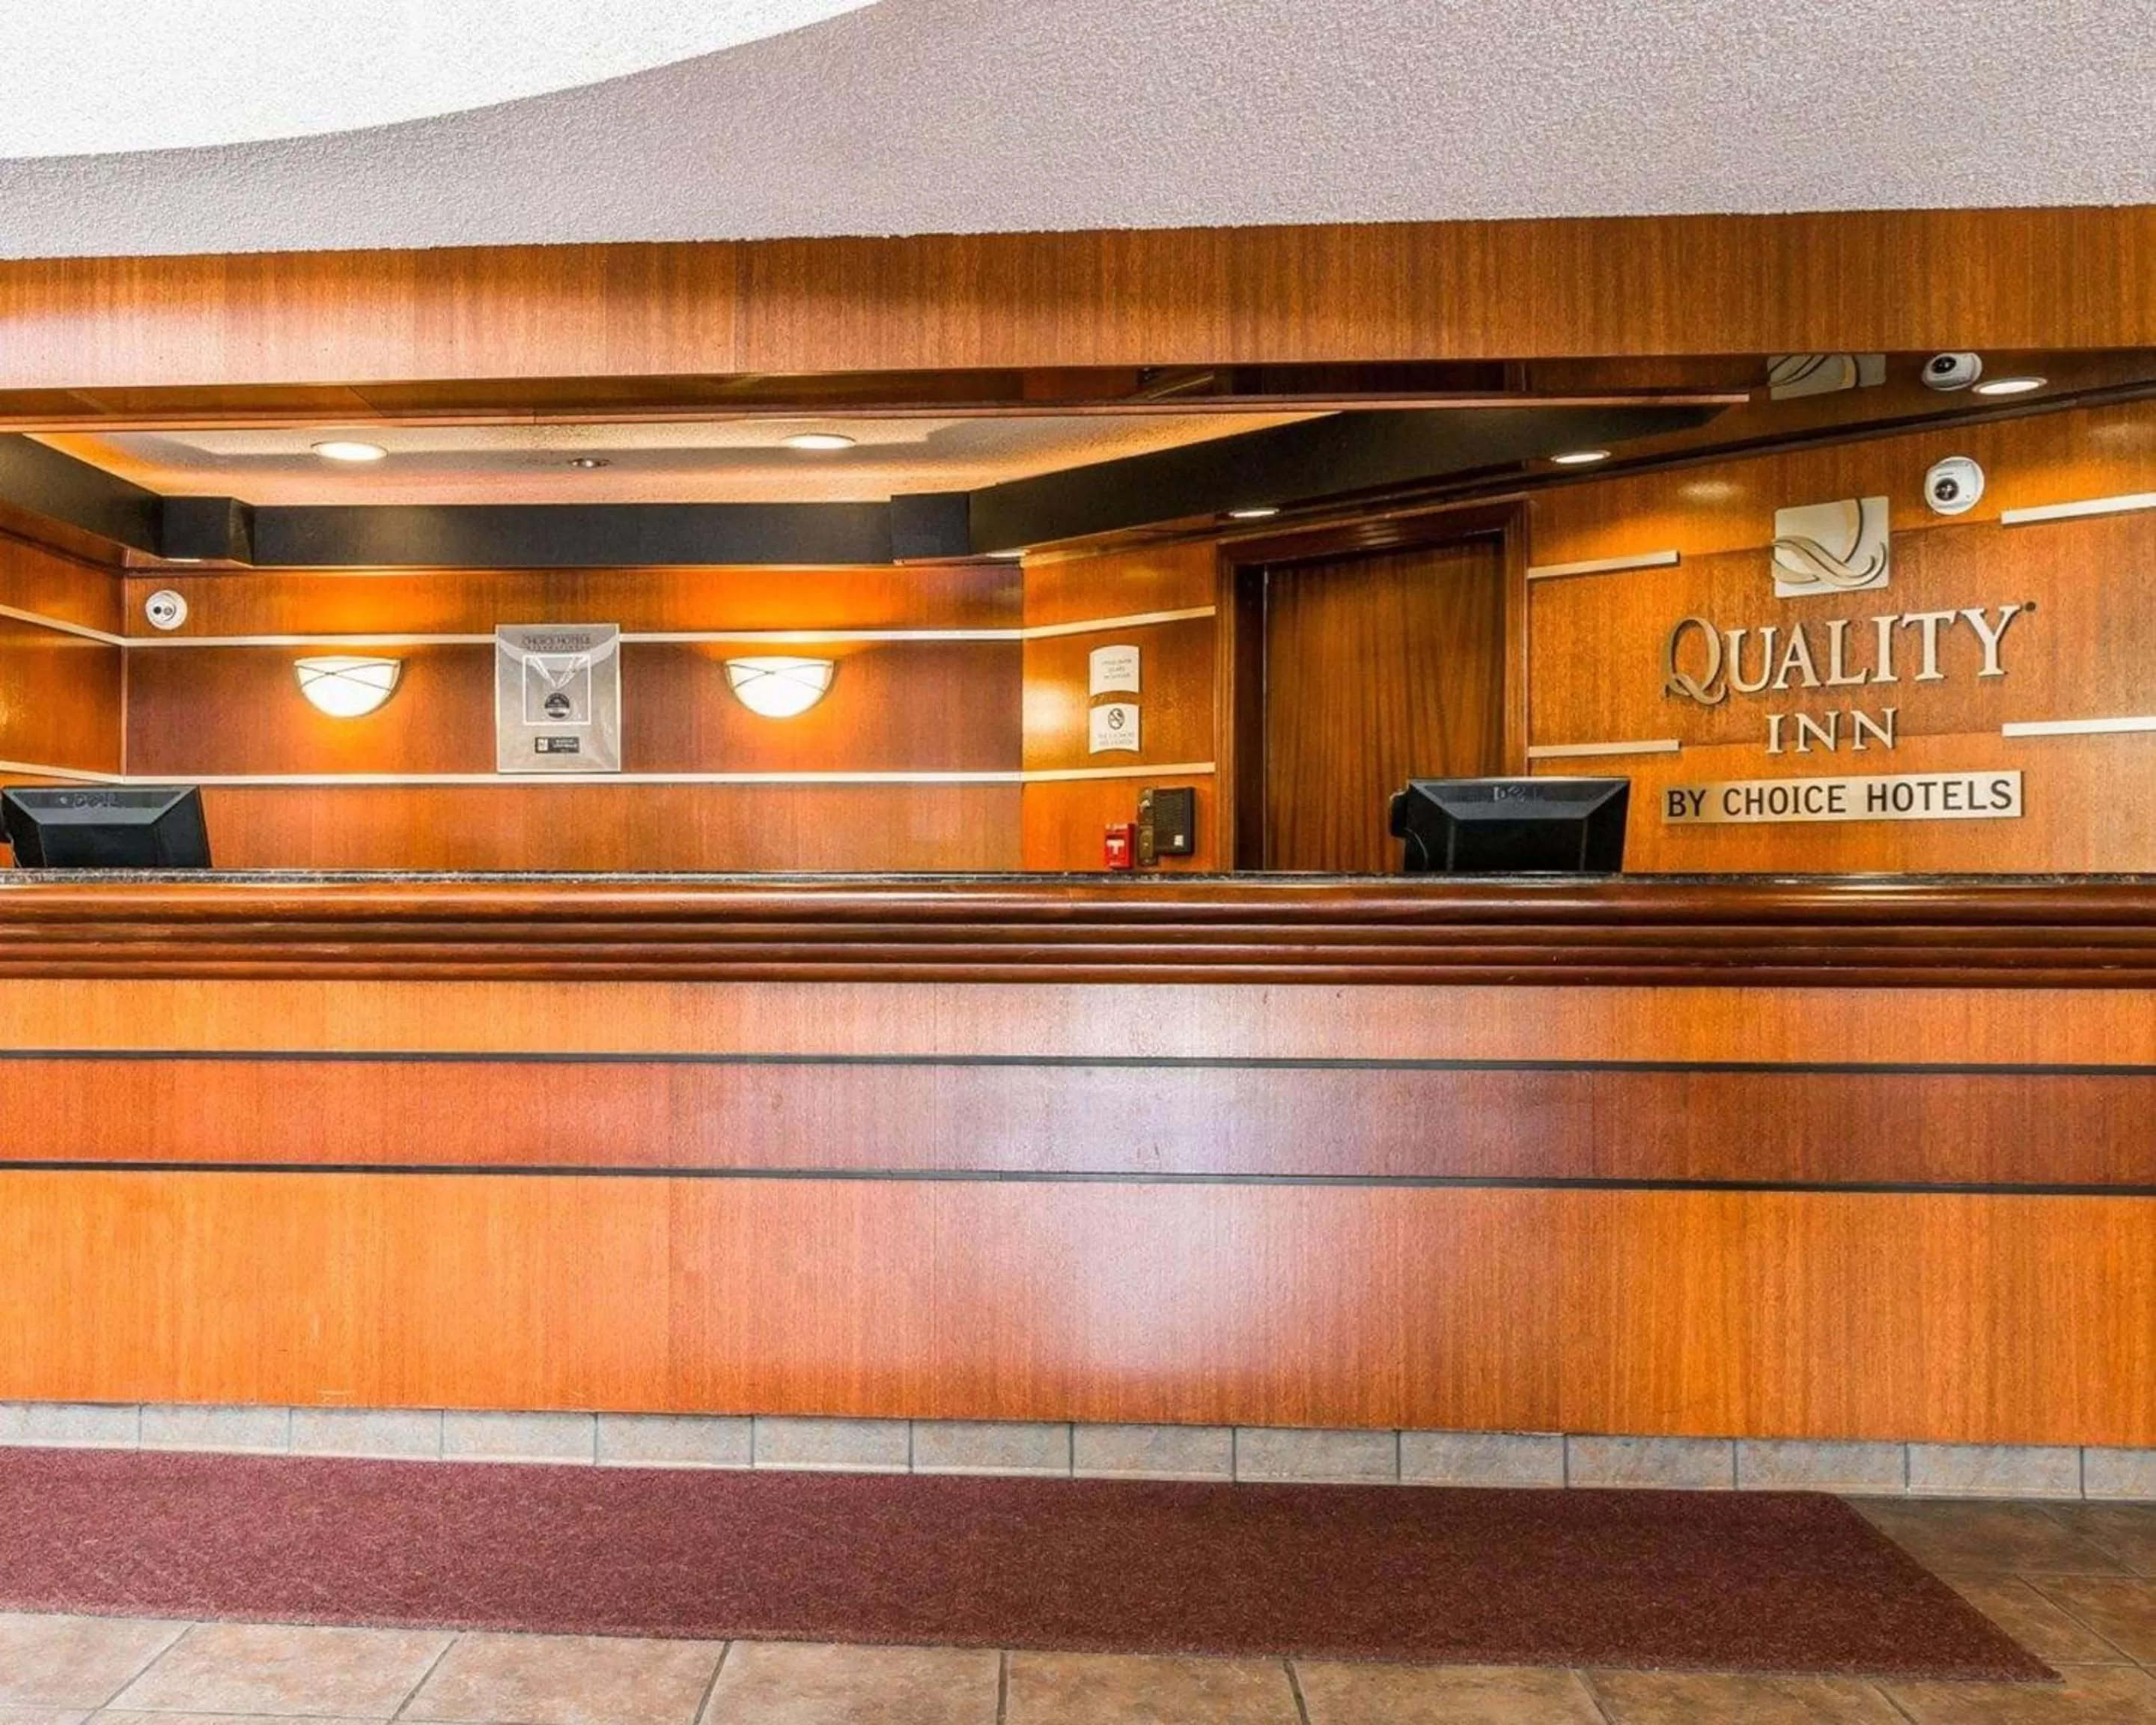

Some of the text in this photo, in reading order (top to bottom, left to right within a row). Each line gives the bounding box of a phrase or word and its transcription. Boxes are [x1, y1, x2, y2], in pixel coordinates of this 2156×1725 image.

[1663, 604, 2023, 706] QUALITY
[1765, 708, 1897, 755] INN
[1667, 779, 2013, 818] BY CHOICE HOTELS
